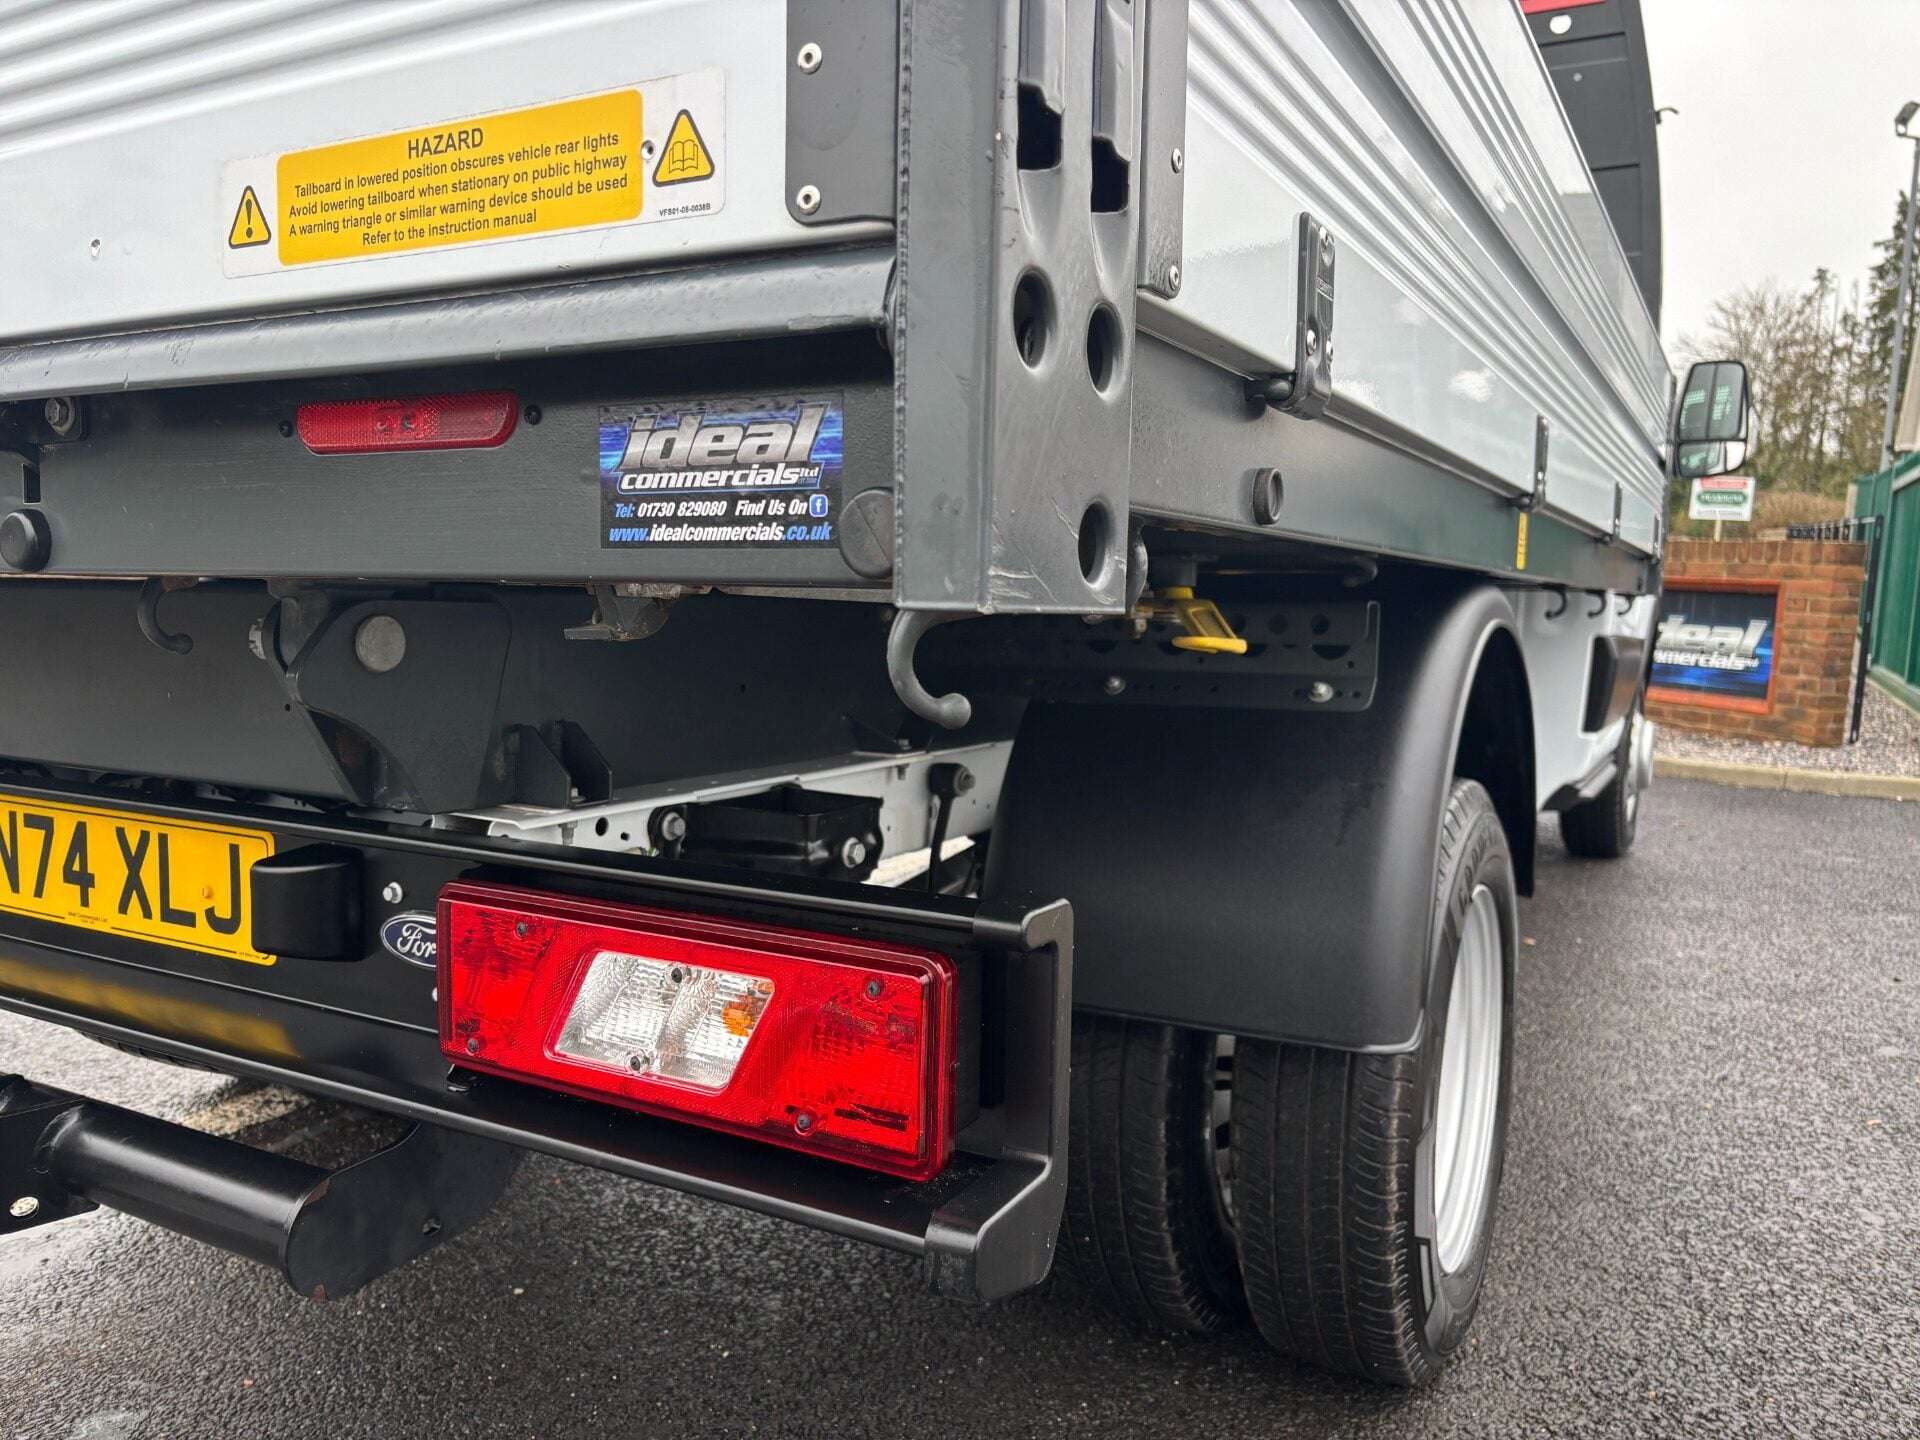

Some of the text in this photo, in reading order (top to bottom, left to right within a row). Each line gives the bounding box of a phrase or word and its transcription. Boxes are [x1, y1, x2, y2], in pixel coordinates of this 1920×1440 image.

[408, 128, 484, 159] HAZARD
[294, 132, 619, 198] Tailboard in lowered position obscures vehicle rear lights
[288, 154, 628, 218] Avoid lowering tailboard when stationary on public highway
[288, 173, 628, 237] A warning triangle or similar warning device should be used
[362, 208, 537, 246] Refer to the instruction manual
[619, 405, 825, 470] ideal
[620, 463, 800, 489] commercials
[615, 503, 636, 518] Tel:
[637, 502, 676, 517] 01730
[677, 500, 728, 517] 829080
[735, 499, 766, 516] Find
[767, 499, 786, 515] Us
[788, 498, 809, 515] On
[609, 521, 832, 542] www.idealcommercials.co.uk
[114, 825, 243, 936] XLJ
[396, 922, 437, 958] For
